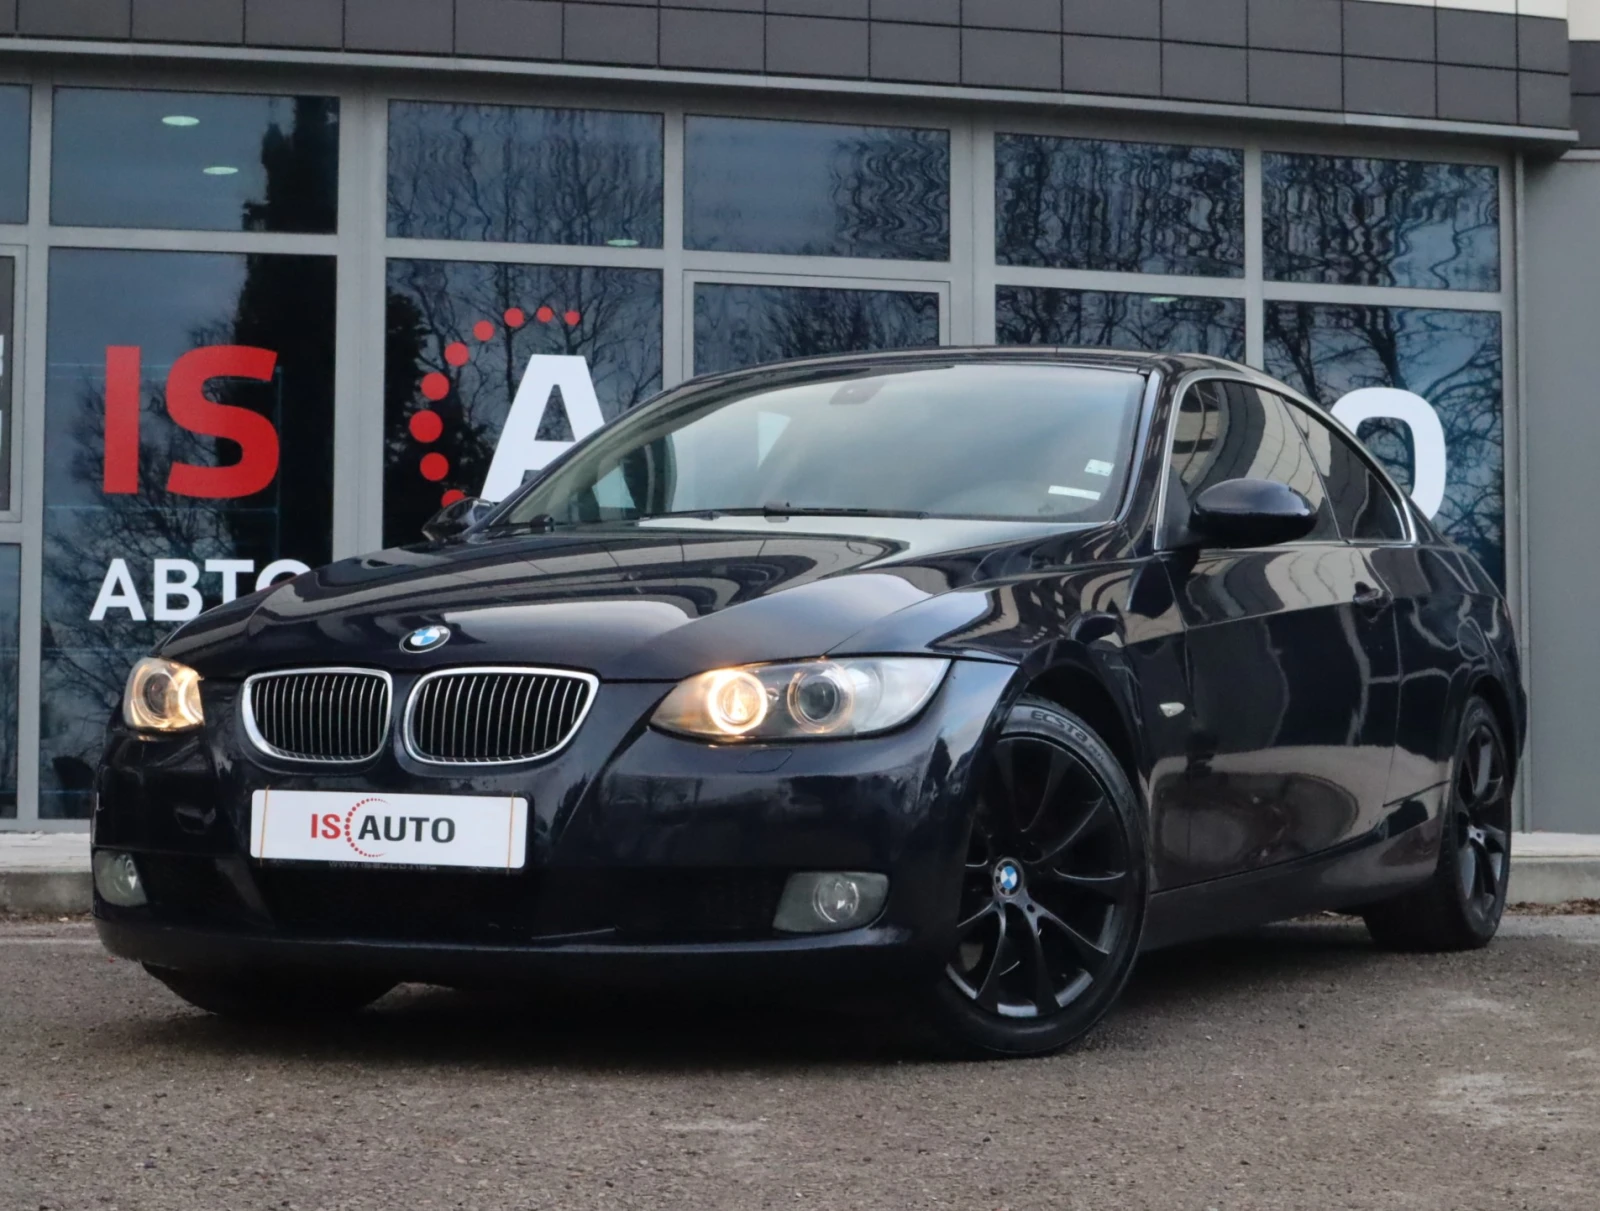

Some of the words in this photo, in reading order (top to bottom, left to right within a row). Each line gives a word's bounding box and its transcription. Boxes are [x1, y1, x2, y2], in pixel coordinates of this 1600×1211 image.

[103, 345, 280, 498] IS
[311, 813, 341, 840] IS
[357, 814, 456, 844] AUTO
